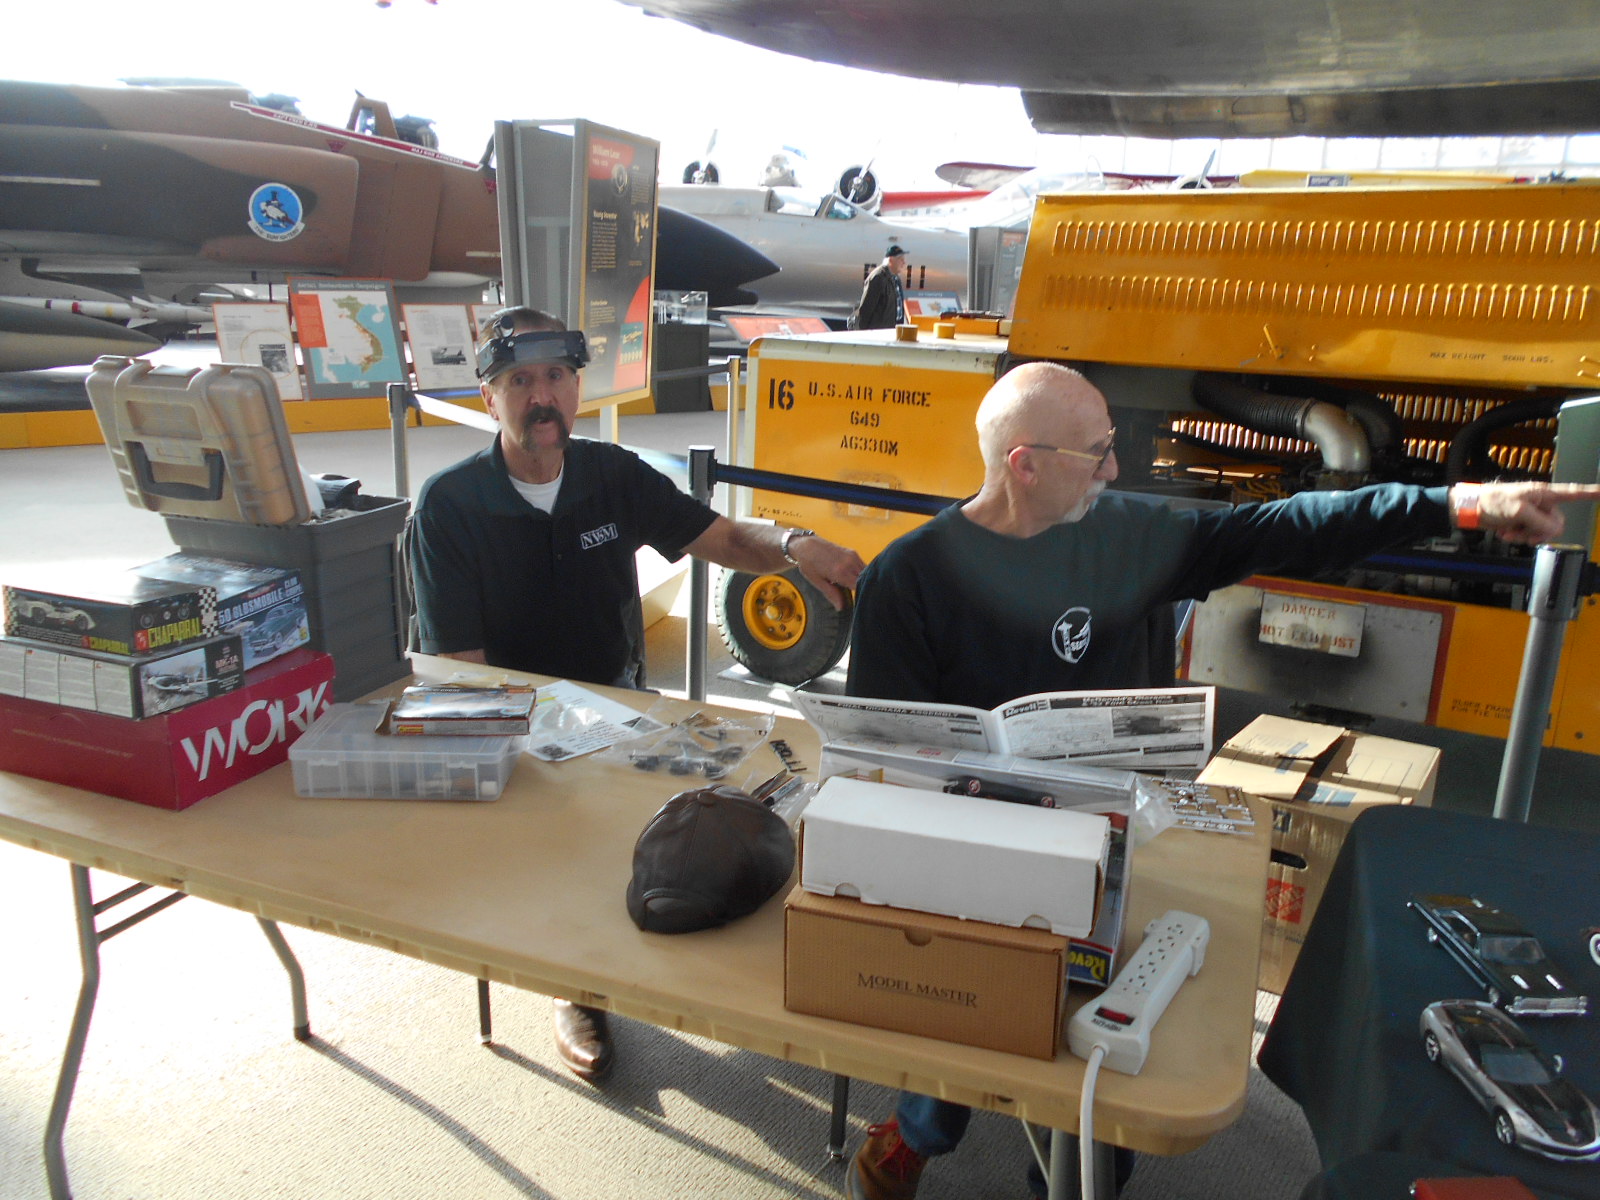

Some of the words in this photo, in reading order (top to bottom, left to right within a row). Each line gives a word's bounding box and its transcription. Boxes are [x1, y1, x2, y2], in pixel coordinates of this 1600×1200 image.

[769, 378, 795, 410] 16
[882, 388, 931, 407] FORCE
[850, 410, 880, 428] 649
[232, 588, 284, 619] OLDSMOBILE
[1281, 602, 1337, 619] DANGER
[865, 704, 907, 714] DIORAMA
[911, 709, 959, 718] ASSEMBLY
[1006, 703, 1037, 717] Revell
[180, 681, 332, 782] WORK
[1067, 951, 1106, 980] Reve
[857, 972, 912, 992] MODEL
[917, 983, 978, 1008] MASTER
